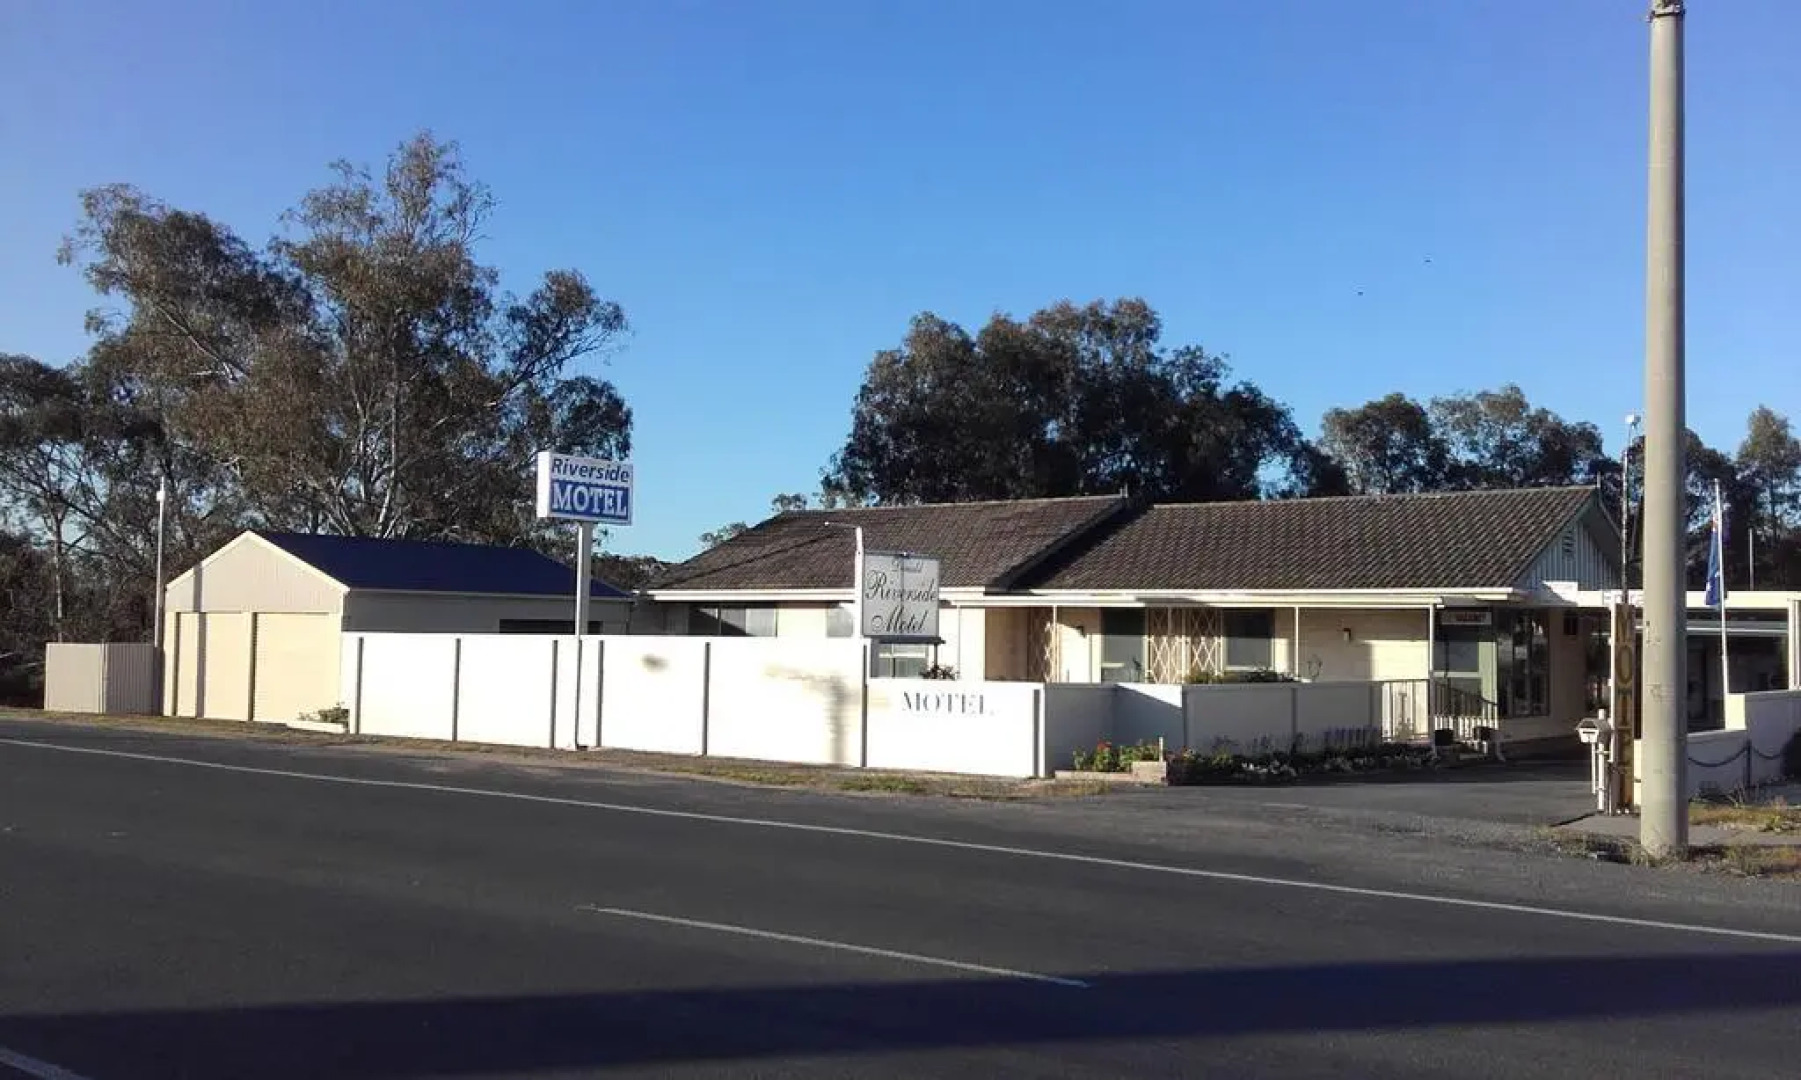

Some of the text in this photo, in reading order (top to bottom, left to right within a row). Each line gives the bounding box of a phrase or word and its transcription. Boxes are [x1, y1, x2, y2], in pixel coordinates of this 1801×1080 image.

[552, 458, 629, 482] Riverside
[552, 482, 627, 516] MOTEL
[865, 569, 937, 602] Riverside
[871, 605, 929, 633] Motel
[902, 692, 994, 715] MOTEL
